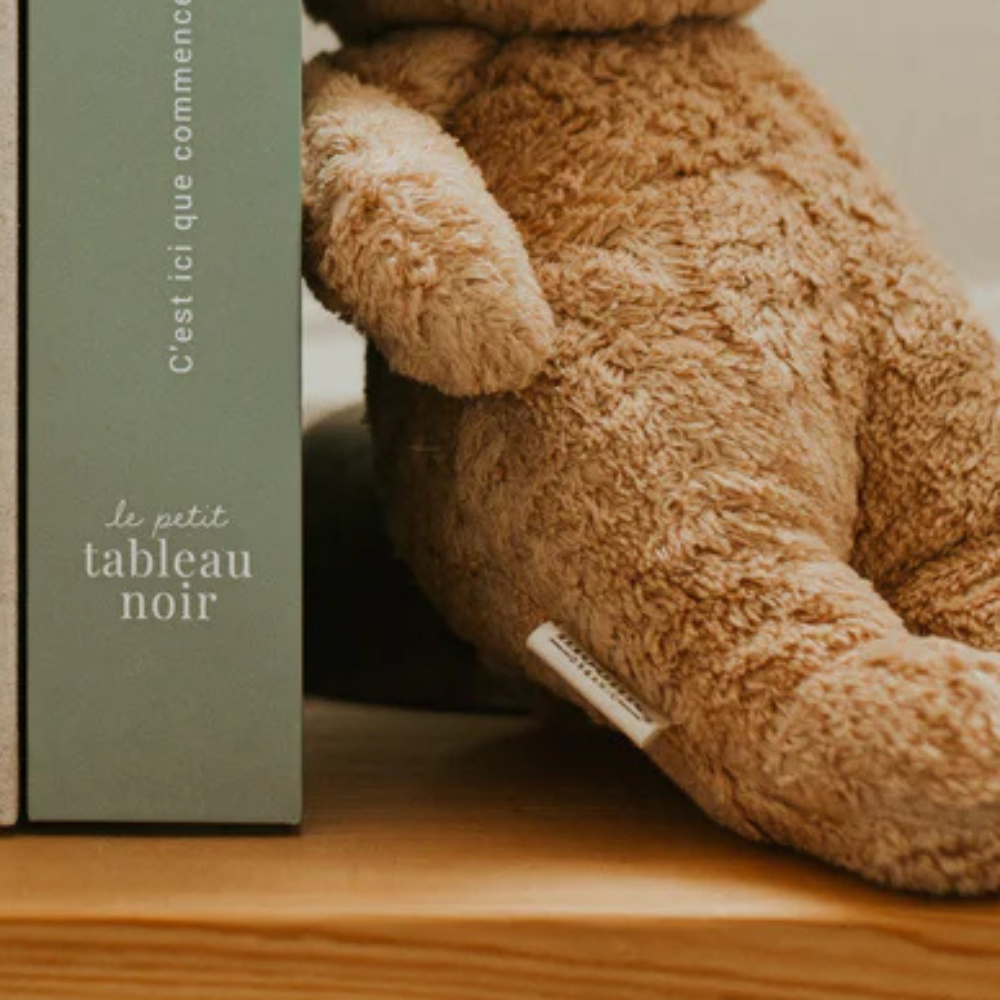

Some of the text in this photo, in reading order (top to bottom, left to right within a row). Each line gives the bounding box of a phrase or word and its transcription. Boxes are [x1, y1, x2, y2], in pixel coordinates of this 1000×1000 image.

[173, 174, 199, 231] que
[166, 243, 193, 282] ici
[167, 294, 194, 375] C'est
[105, 499, 230, 538] le petit
[84, 537, 253, 579] tableau
[120, 581, 218, 620] noir
